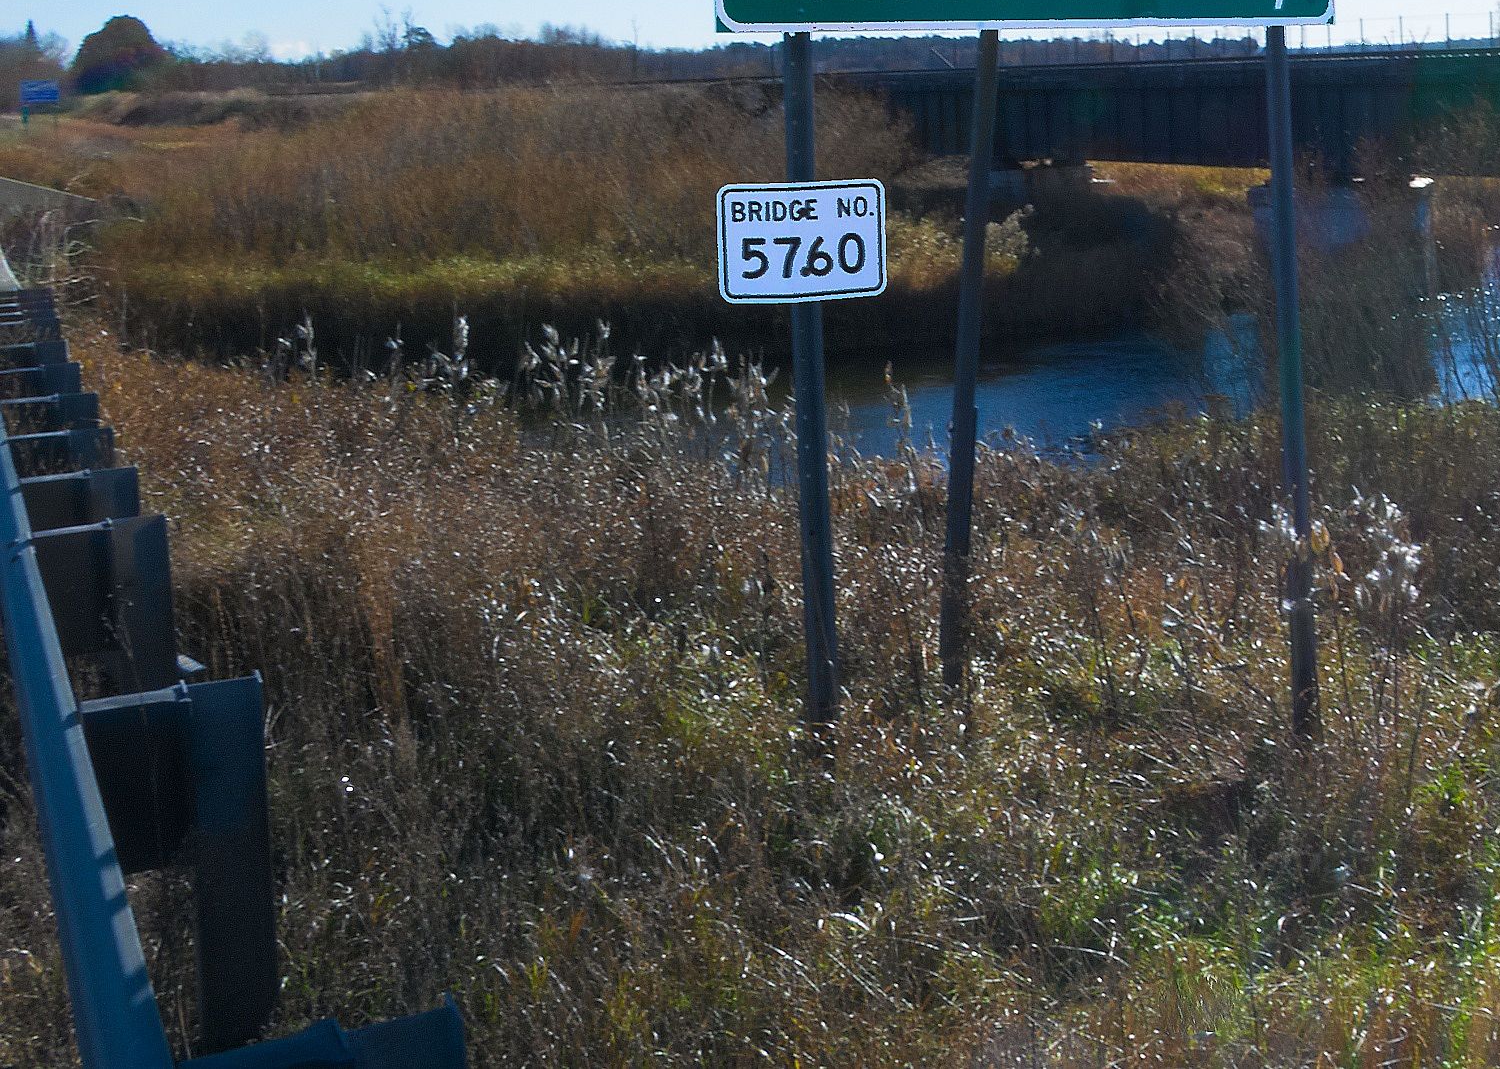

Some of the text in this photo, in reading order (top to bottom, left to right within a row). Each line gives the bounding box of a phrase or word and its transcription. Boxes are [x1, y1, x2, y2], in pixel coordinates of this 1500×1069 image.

[731, 196, 875, 222] BRIDGE NO.
[741, 232, 866, 279] 5760
